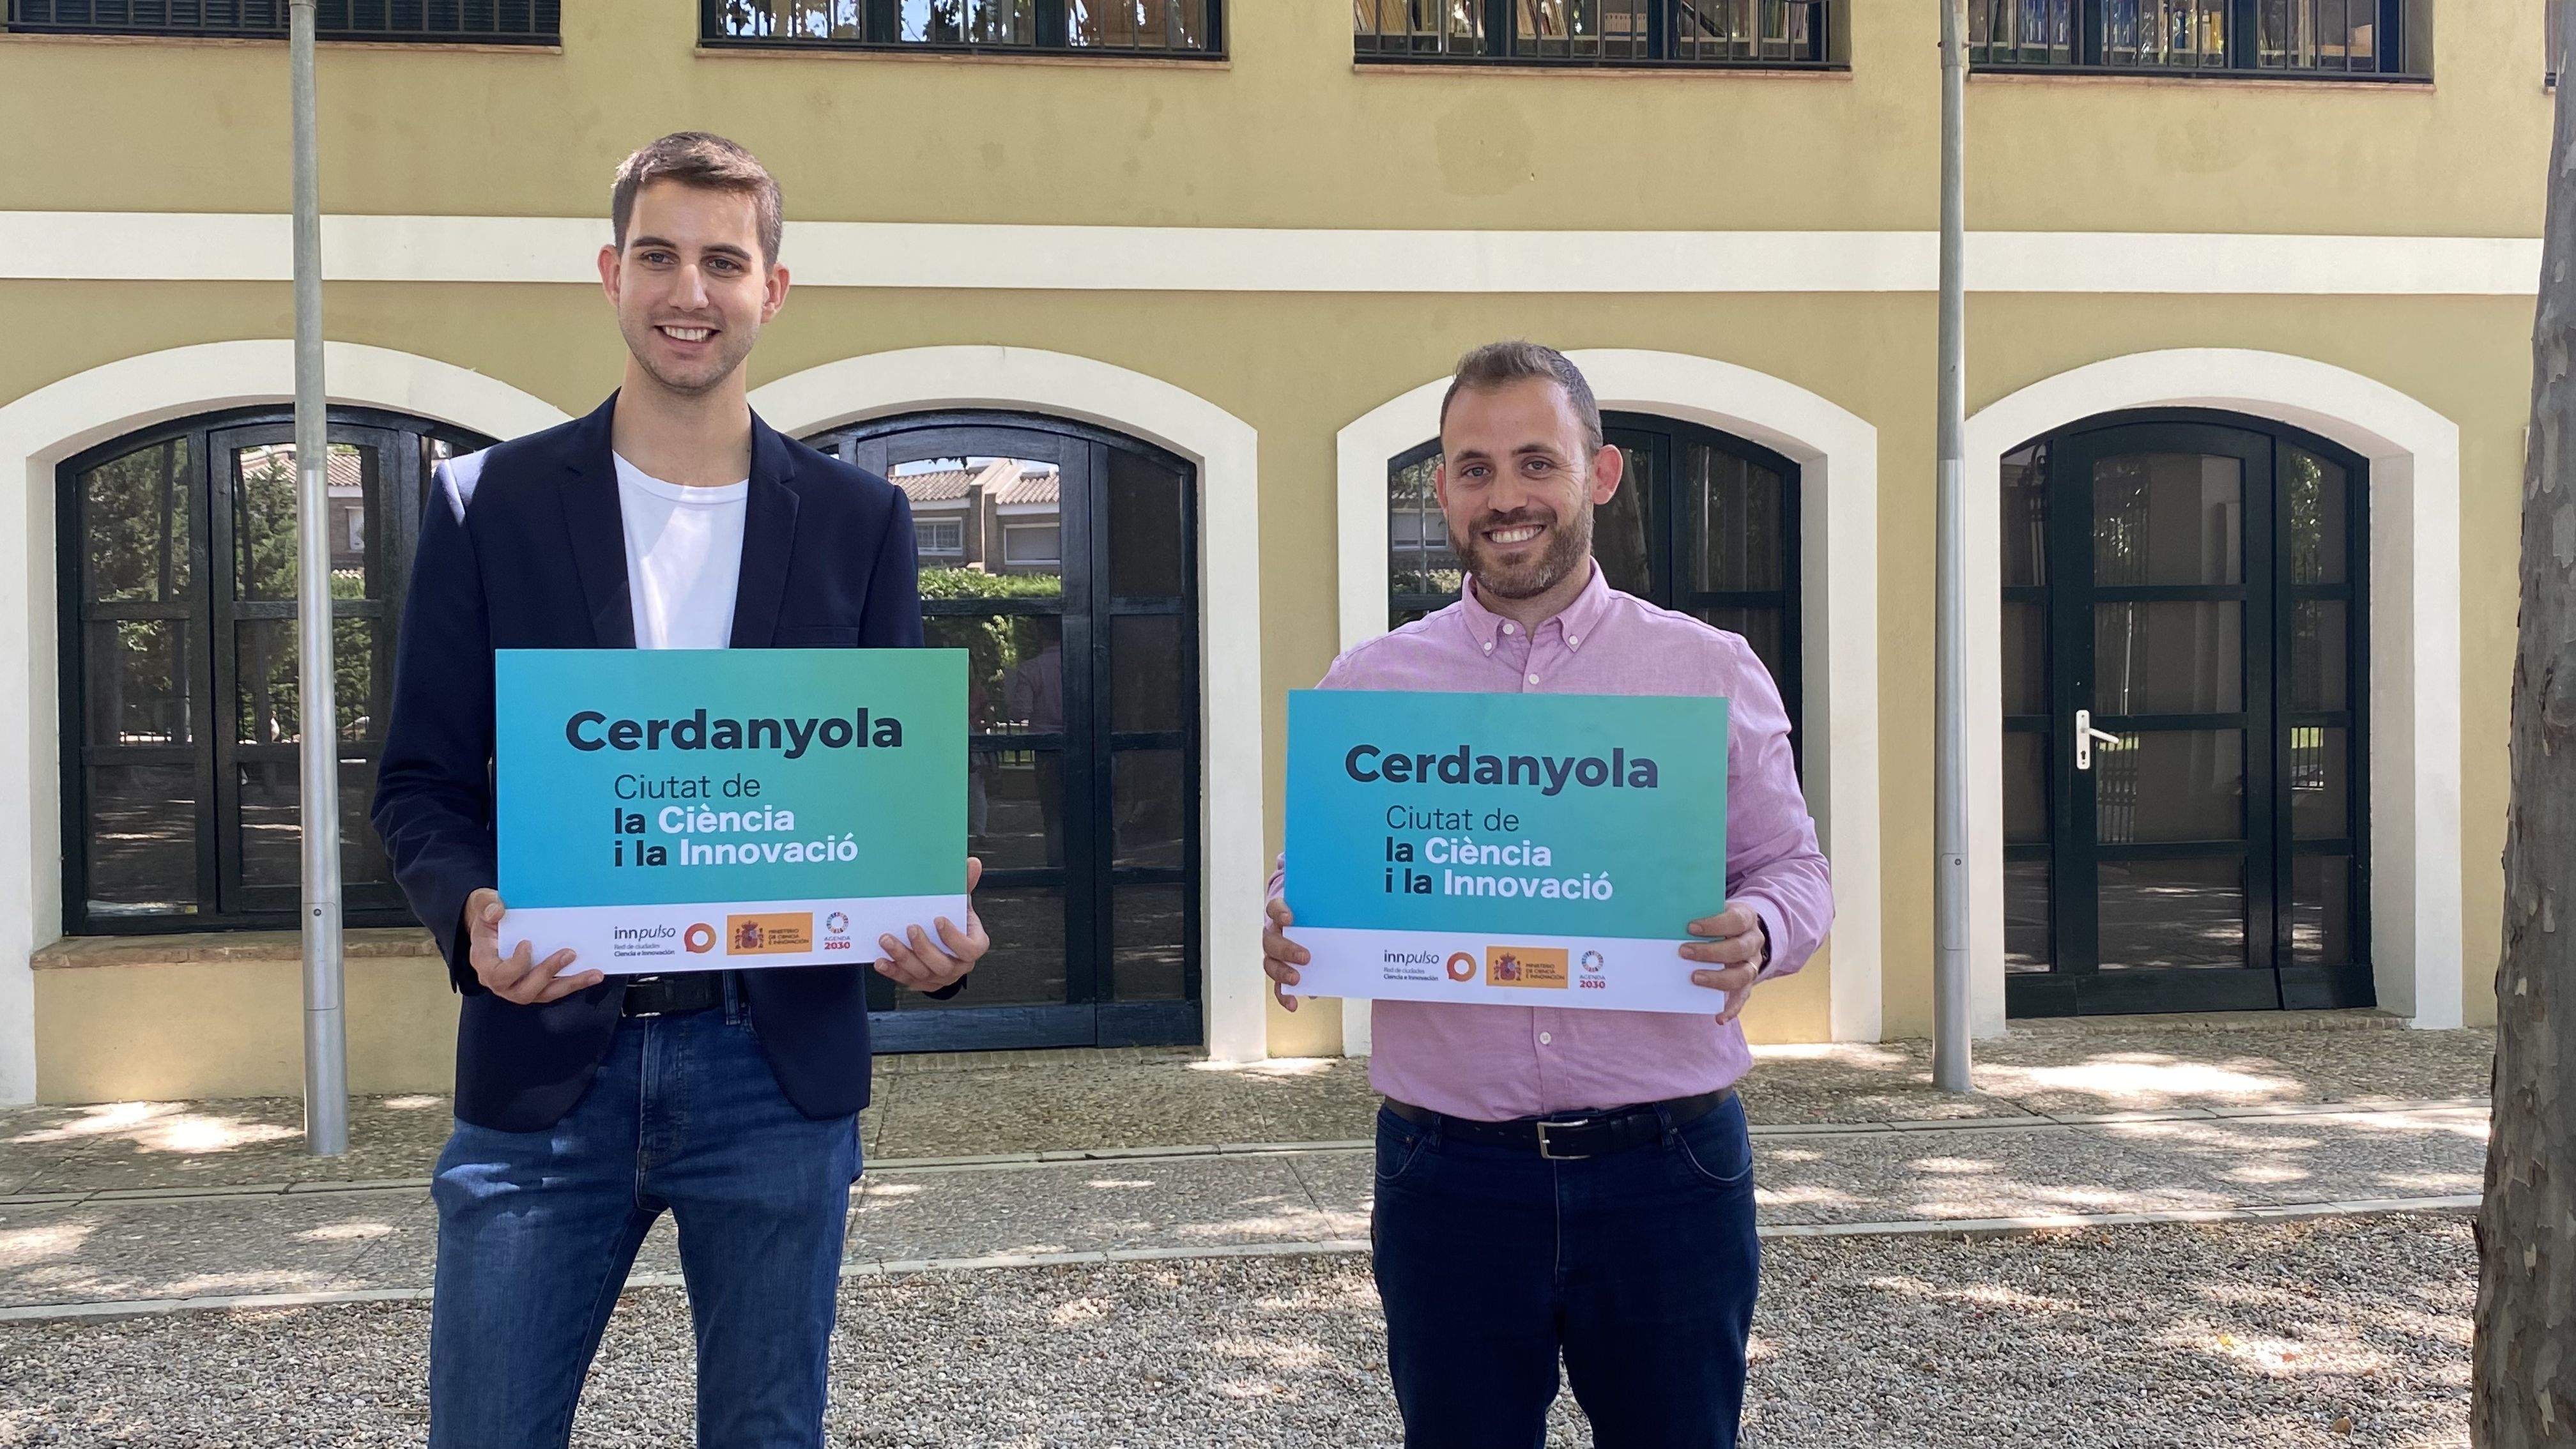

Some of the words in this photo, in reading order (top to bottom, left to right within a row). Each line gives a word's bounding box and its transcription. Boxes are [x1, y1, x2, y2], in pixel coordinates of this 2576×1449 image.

[565, 708, 903, 759] Cerdanyola
[1345, 744, 1659, 796] Cerdanyola
[614, 774, 712, 799] Ciutat
[723, 773, 761, 798] de
[614, 808, 646, 834] la
[658, 804, 795, 833] Ciència
[1386, 805, 1473, 831] Ciutat
[1483, 808, 1520, 832] de
[614, 841, 623, 867] i
[636, 839, 668, 866] la
[679, 832, 859, 866] Innovació
[1386, 836, 1414, 862] la
[1424, 836, 1552, 866] Ciència
[1385, 868, 1393, 894] i
[1404, 868, 1432, 894] la
[1444, 869, 1614, 901] Innovació
[614, 924, 676, 942] innpulso
[824, 942, 851, 950] 2030
[1384, 949, 1439, 966] innpulso
[1579, 980, 1606, 988] 2030
